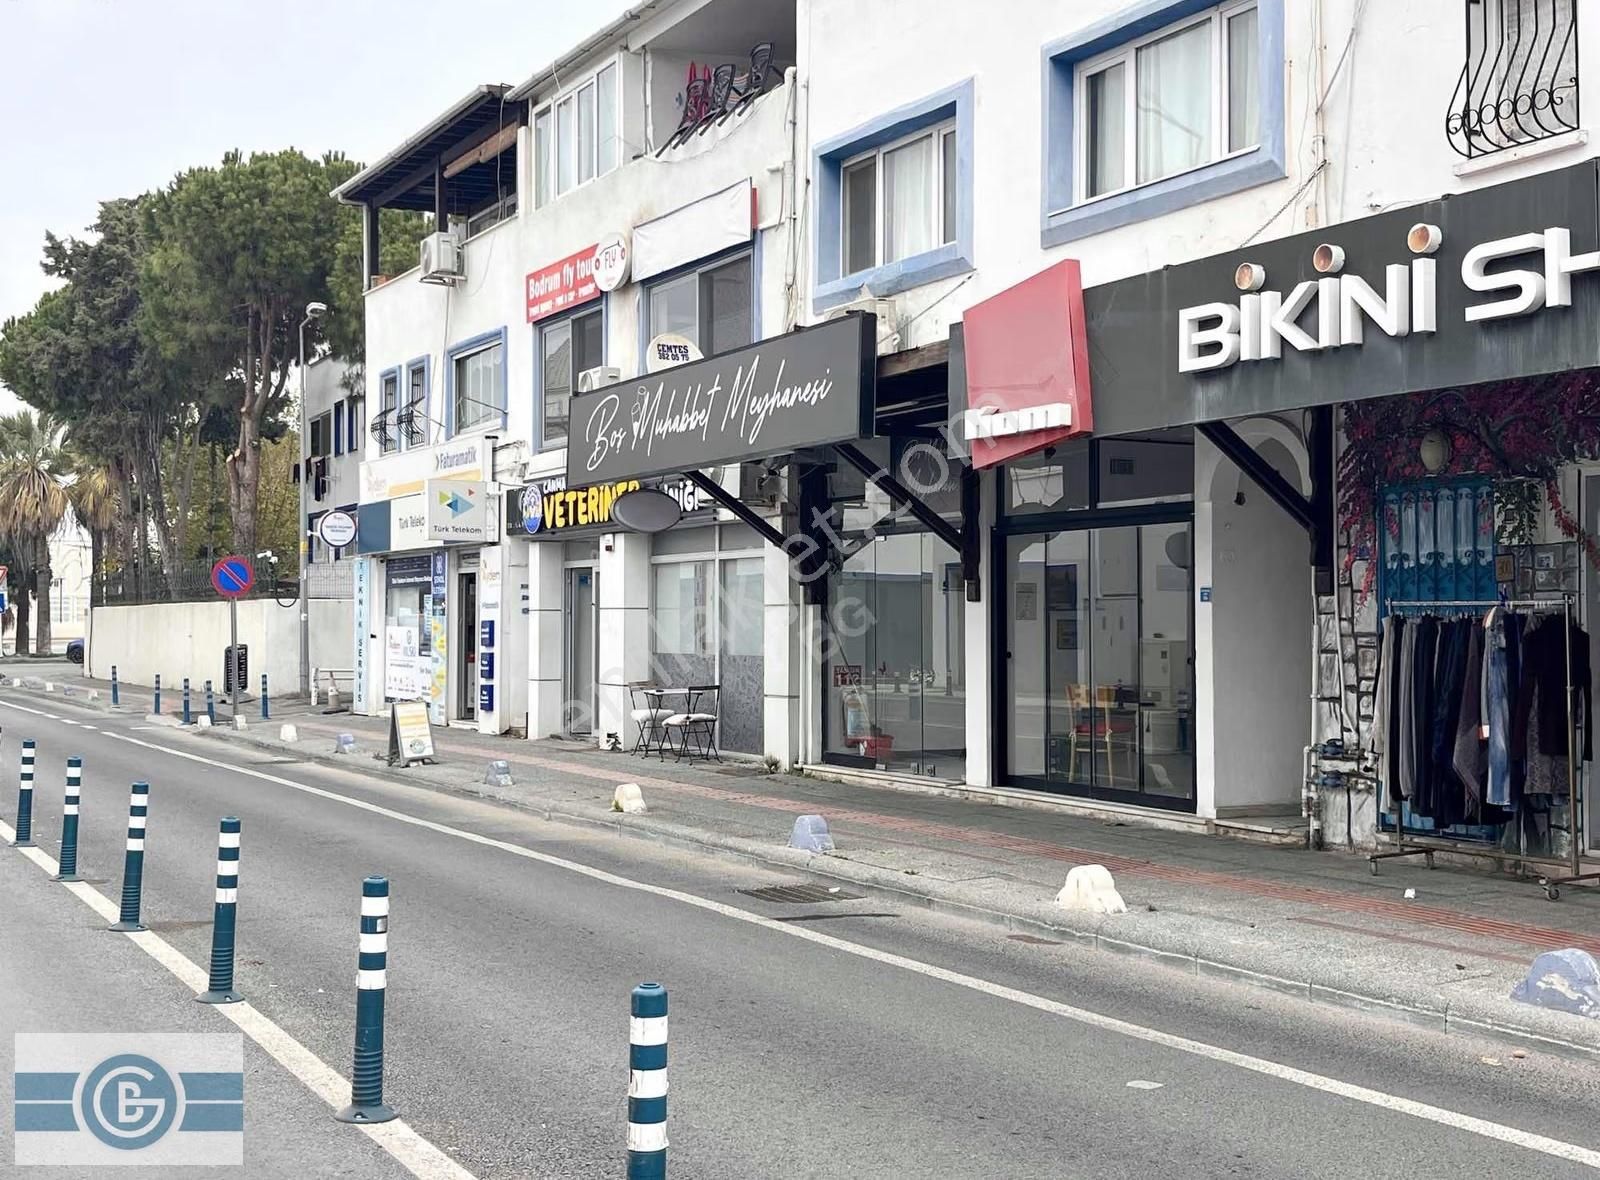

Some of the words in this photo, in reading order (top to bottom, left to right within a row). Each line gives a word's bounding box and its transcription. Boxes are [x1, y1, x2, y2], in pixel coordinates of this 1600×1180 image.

[529, 272, 560, 300] Bodrum
[563, 262, 575, 289] fly
[632, 373, 721, 456] Muhabbet
[721, 355, 832, 445] Meyhanesi
[434, 525, 449, 533] Türk
[452, 525, 482, 534] Telekom
